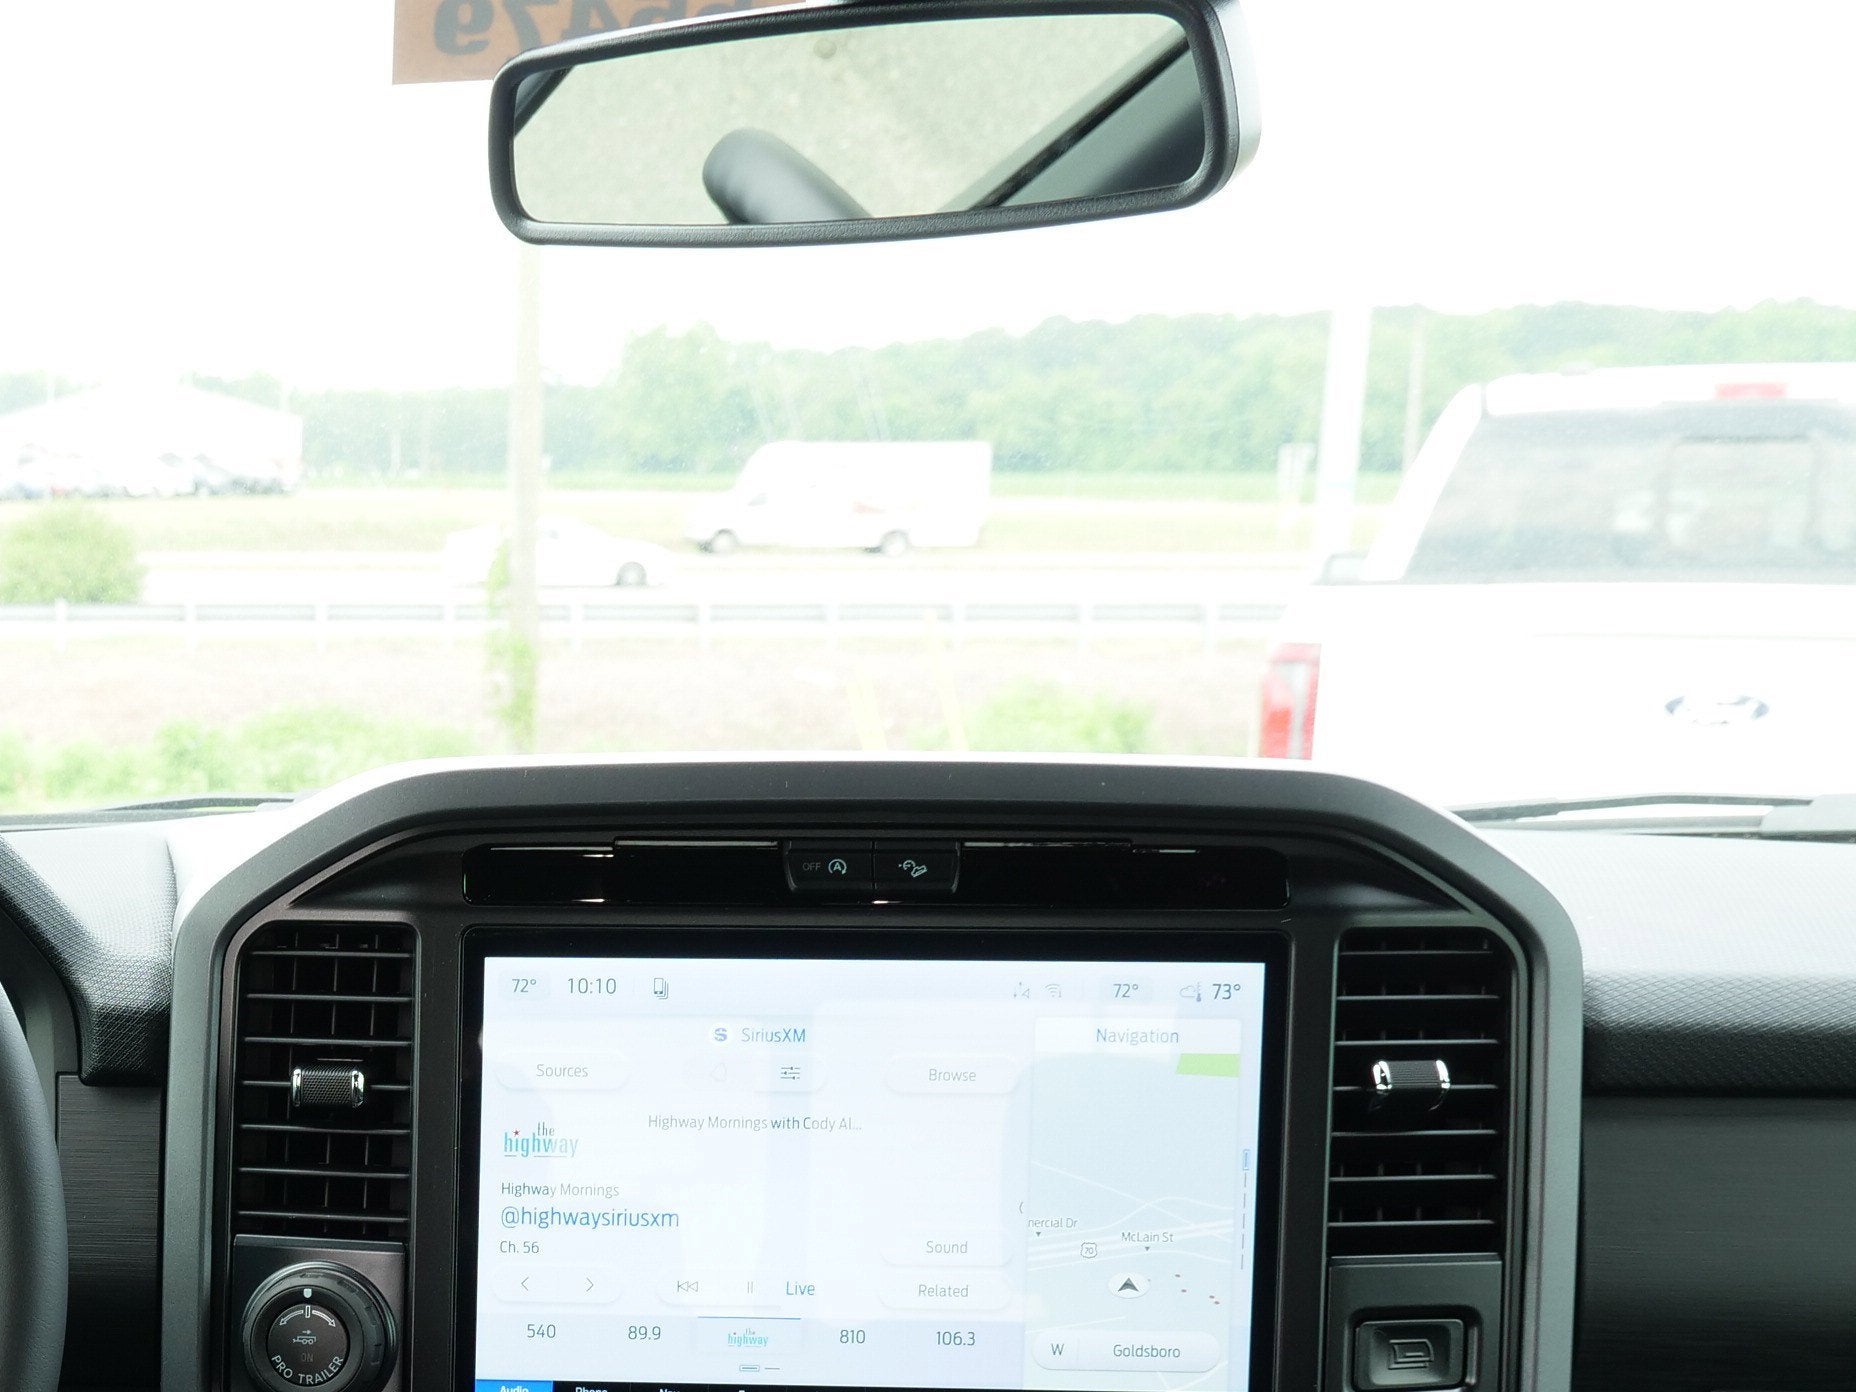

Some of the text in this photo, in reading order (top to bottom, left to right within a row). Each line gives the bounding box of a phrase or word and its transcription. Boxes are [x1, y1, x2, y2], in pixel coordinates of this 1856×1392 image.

[511, 978, 537, 993] 72°
[567, 977, 617, 995] 10:10
[1112, 983, 1139, 998] 72°
[1212, 983, 1241, 1000] 73°
[741, 1028, 806, 1043] SiriusXM
[1096, 1028, 1180, 1046] Navigation
[536, 1064, 589, 1078] Sources
[928, 1068, 977, 1082] Browse
[537, 1122, 555, 1137] the
[648, 1115, 705, 1130] Highway
[708, 1115, 768, 1131] Mornings
[770, 1116, 800, 1131] with
[802, 1116, 836, 1132] Cody
[504, 1132, 579, 1158] highway
[501, 1183, 620, 1199] Highway Mornings
[501, 1206, 679, 1229] @highwaysiriusxm
[1066, 1218, 1078, 1228] Dr
[1121, 1232, 1174, 1243] McLain St
[499, 1241, 540, 1253] Ch. 56
[926, 1240, 968, 1254] Sound
[785, 1281, 815, 1296] Live
[918, 1284, 969, 1298] Related
[526, 1324, 556, 1338] 540
[628, 1326, 661, 1340] 89.9
[839, 1329, 866, 1344] 810
[936, 1331, 976, 1346] 106.3
[727, 1333, 769, 1347] highway
[1051, 1343, 1065, 1356] W
[1113, 1344, 1181, 1358] Goldsboro
[272, 1354, 344, 1385] PRO TRAILER
